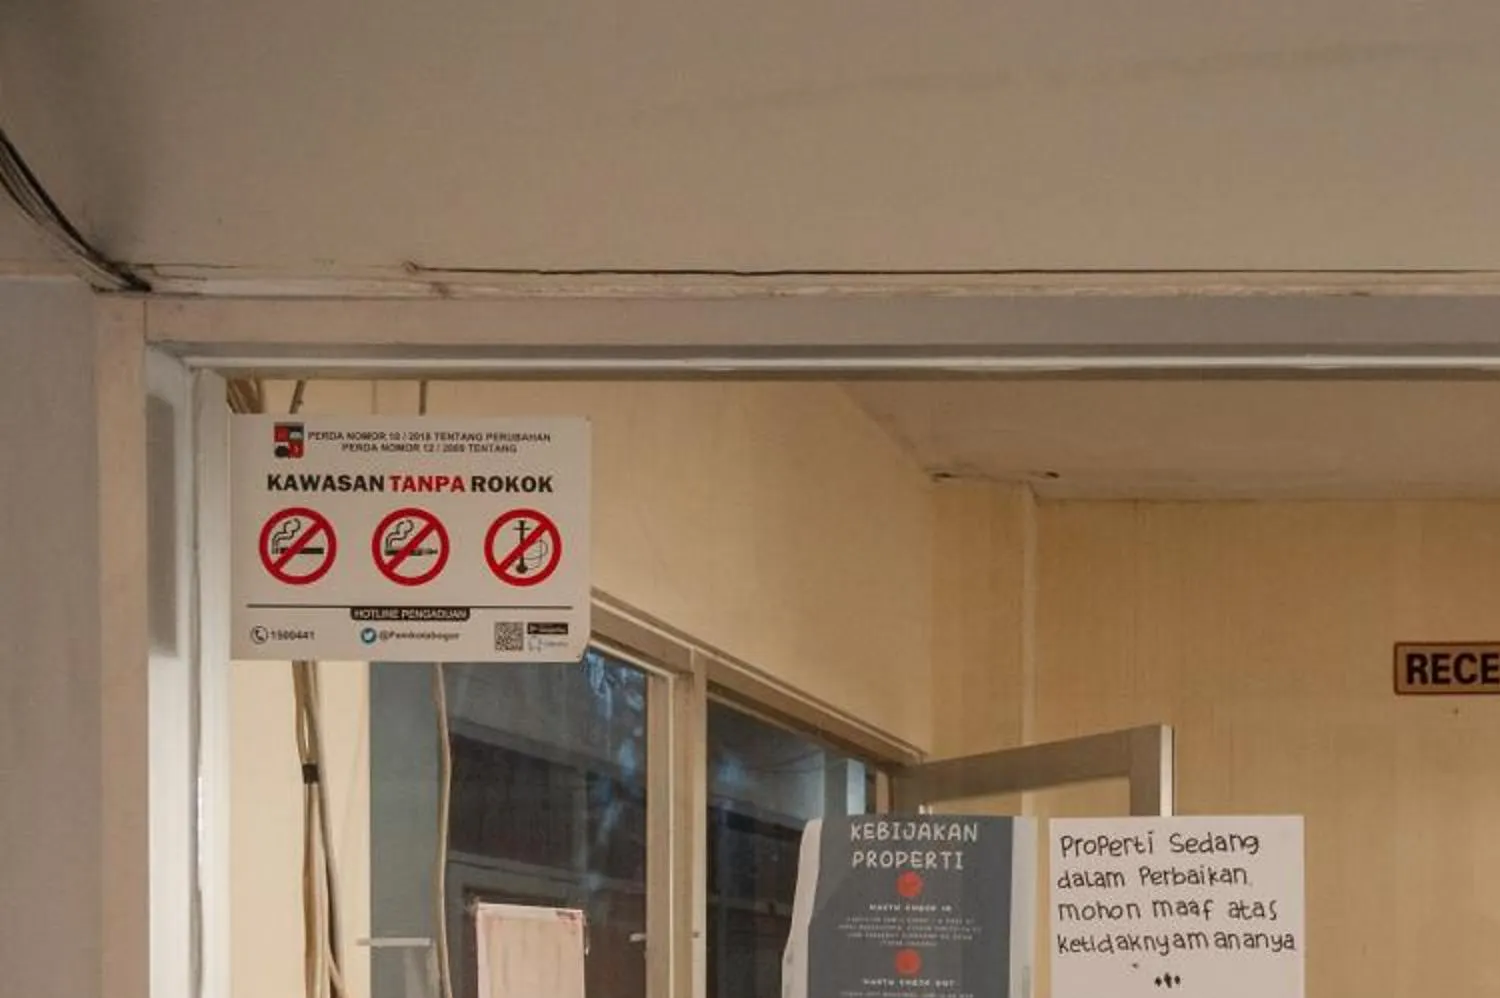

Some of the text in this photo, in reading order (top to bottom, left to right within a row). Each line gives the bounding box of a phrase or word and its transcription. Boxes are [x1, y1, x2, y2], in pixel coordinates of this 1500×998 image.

[434, 432, 483, 442] TENTANG
[486, 432, 551, 442] PERUBAHAN
[468, 443, 517, 453] TENTANG
[267, 474, 553, 494] KAWASAN TANPA ROKOK
[353, 608, 468, 619] HOTLINE PENGADUAN
[850, 821, 978, 842] KEBIJAKAN
[1169, 832, 1259, 855] Sedang
[852, 850, 964, 870] PROPERTI
[1057, 899, 1278, 921] mohon maaf atas
